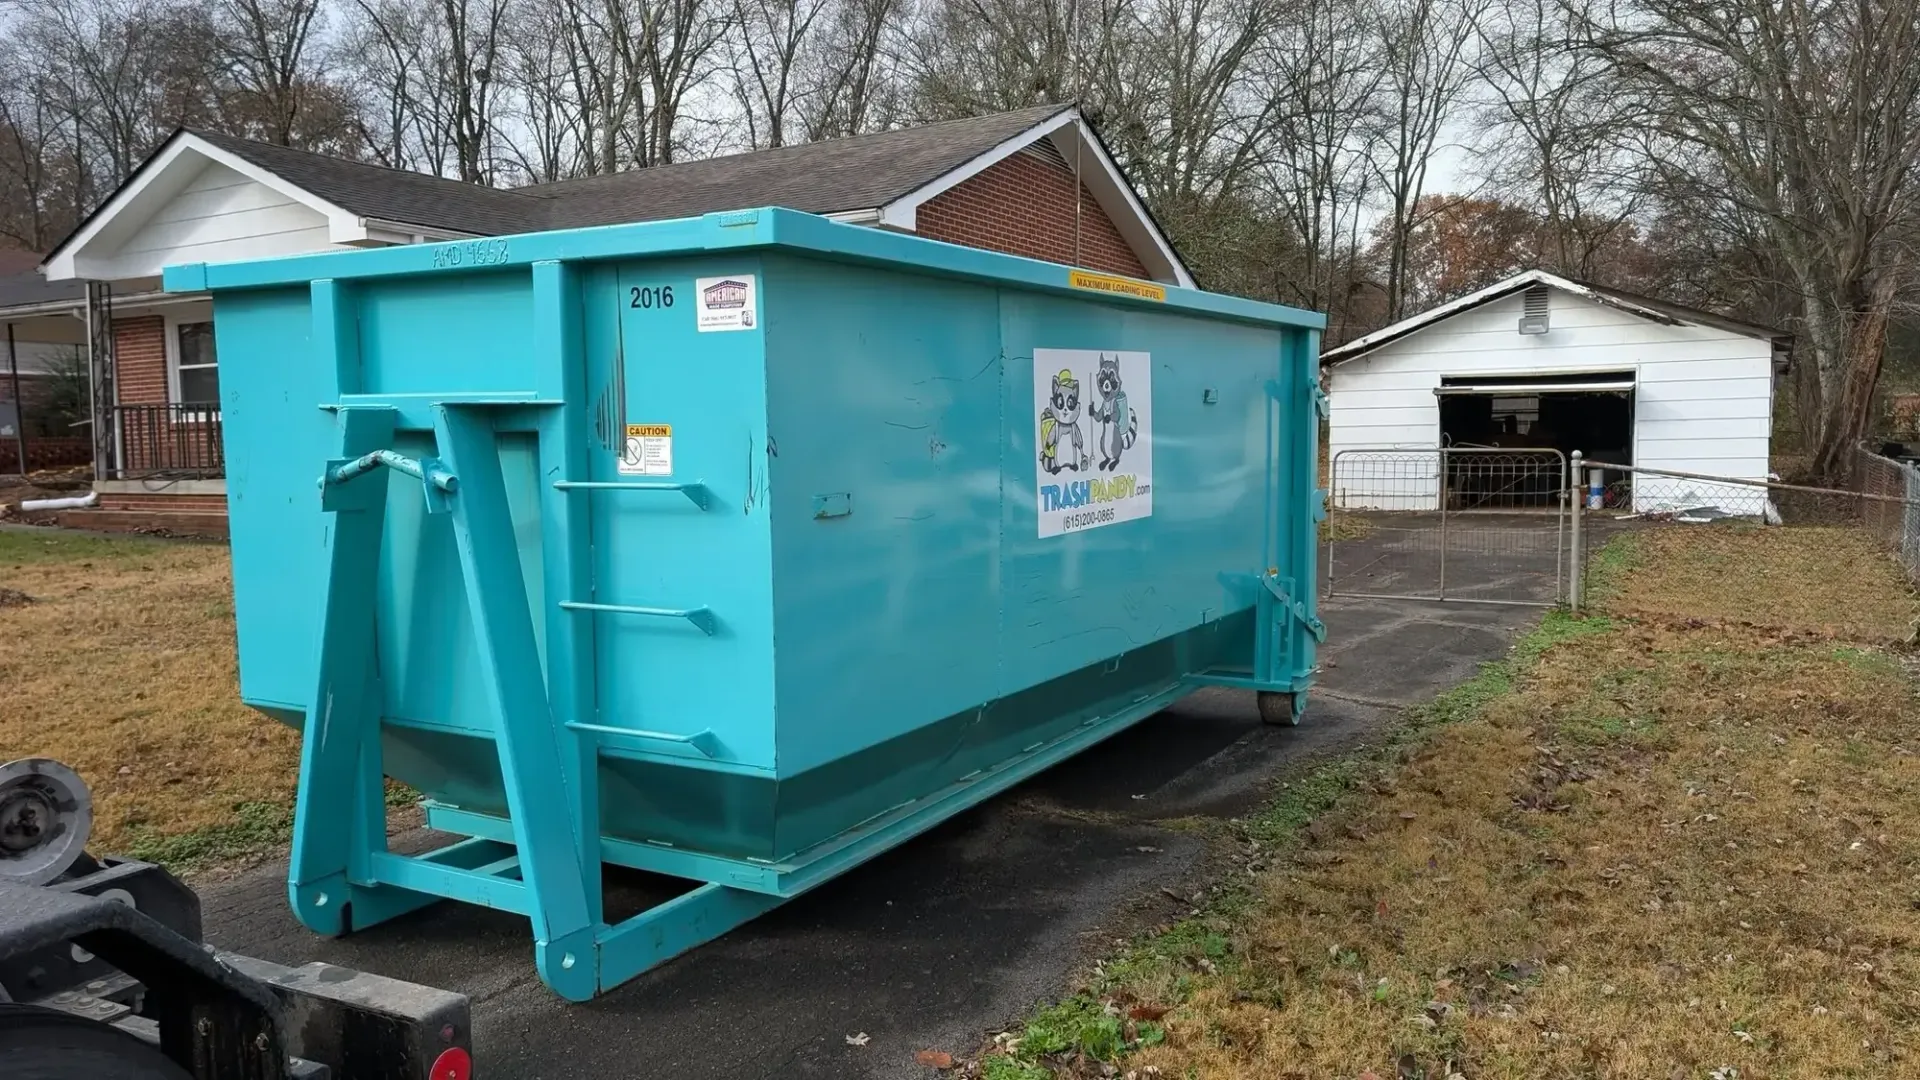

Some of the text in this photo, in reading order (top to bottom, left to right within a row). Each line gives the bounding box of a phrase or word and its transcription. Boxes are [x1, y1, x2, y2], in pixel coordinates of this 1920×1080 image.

[630, 286, 674, 309] 2016
[706, 286, 746, 302] AMERICAN
[1076, 278, 1160, 299] MAXIMUM LOADING LEVEL
[629, 427, 667, 435] CAUTION
[1063, 508, 1115, 532] (615)200-0865
